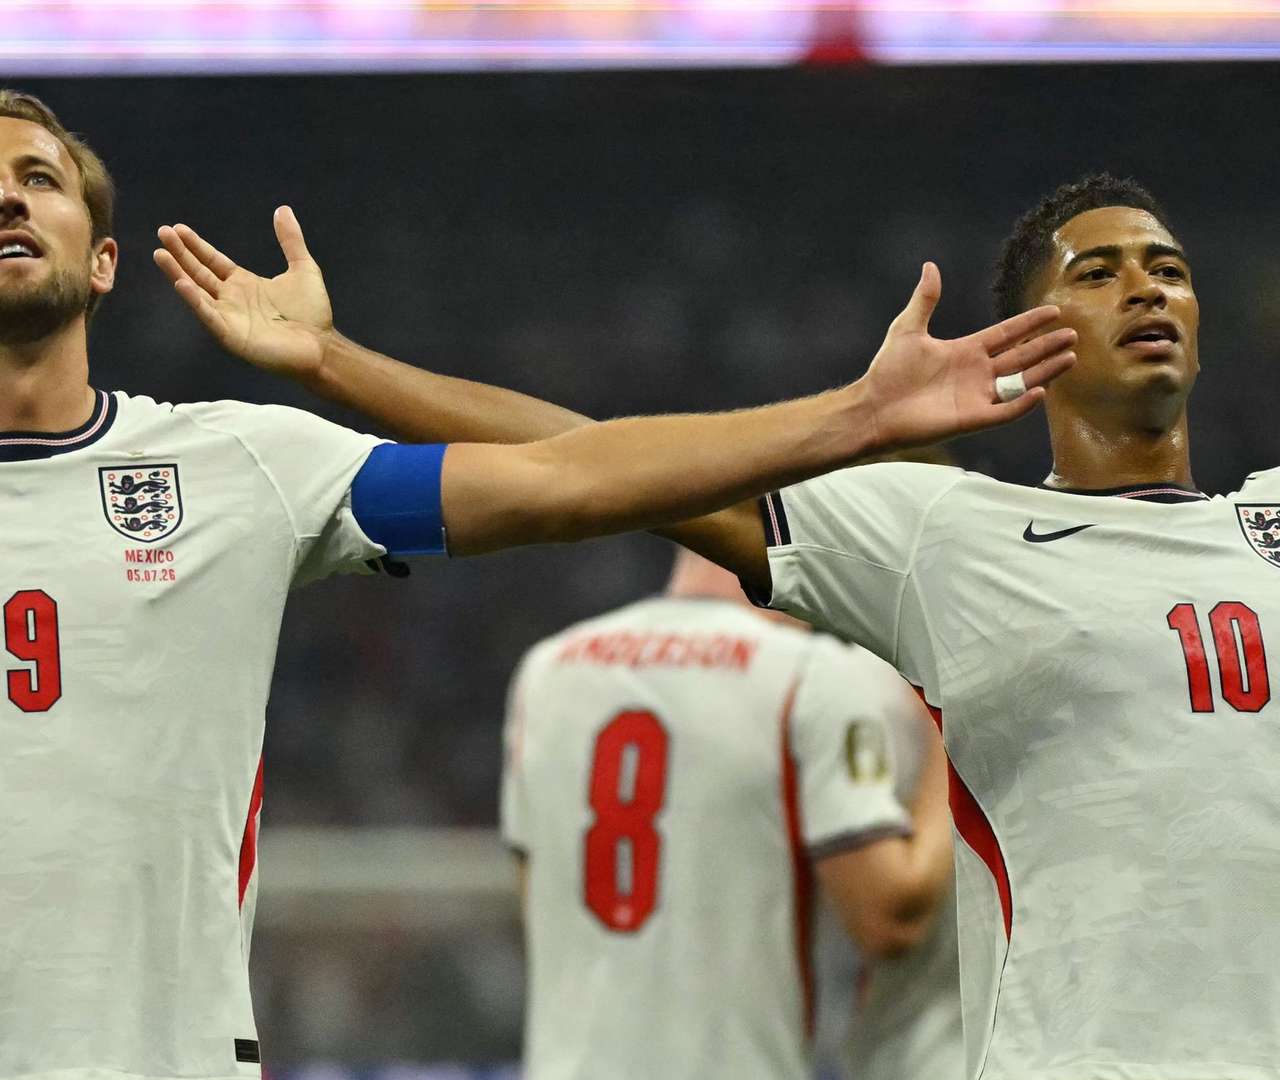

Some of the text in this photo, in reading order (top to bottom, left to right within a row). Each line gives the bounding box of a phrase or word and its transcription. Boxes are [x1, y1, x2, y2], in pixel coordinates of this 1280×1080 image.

[124, 549, 174, 564] MEXICO
[126, 568, 177, 582] 05.07.26
[3, 588, 62, 713] 9
[1166, 600, 1271, 713] 10
[582, 708, 670, 934] 8
